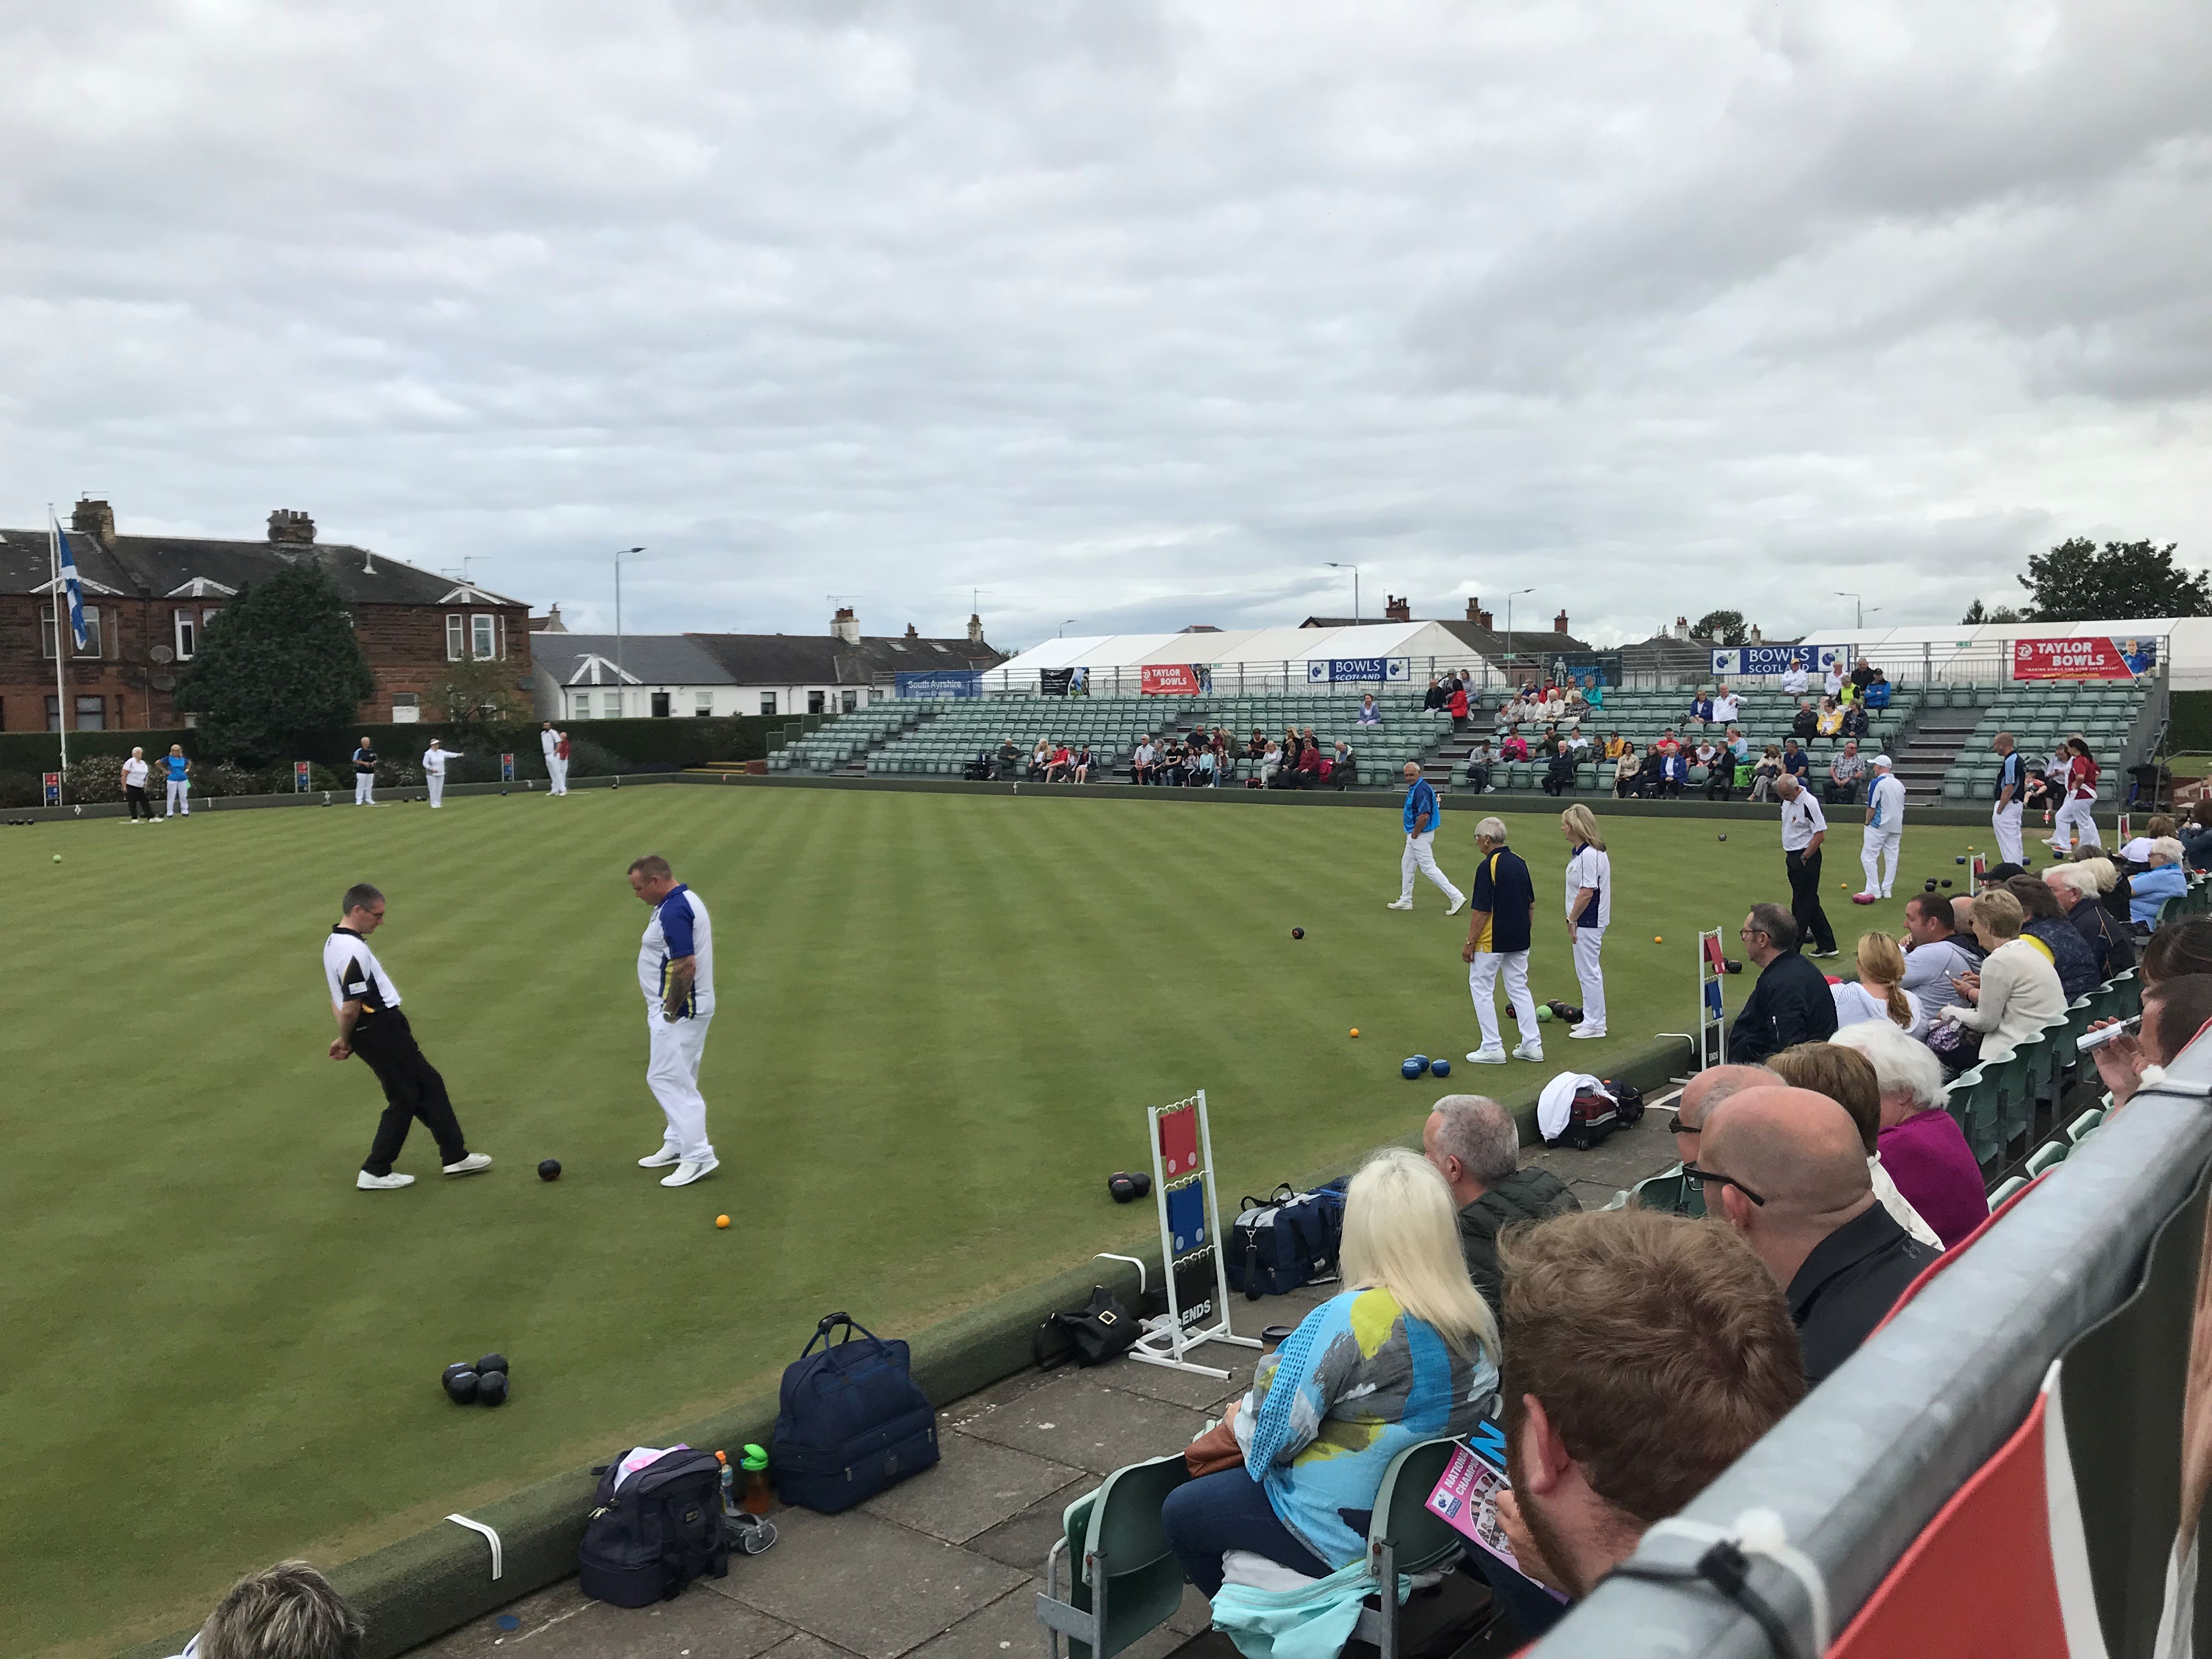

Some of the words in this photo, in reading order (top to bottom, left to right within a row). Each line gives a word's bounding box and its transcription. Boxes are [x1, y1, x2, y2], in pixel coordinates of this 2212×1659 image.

[2037, 642, 2092, 654] TAYLOR
[1749, 647, 1809, 662] BOWLS
[2052, 654, 2104, 666] BOWLS
[1336, 660, 1380, 673] BOWLS
[1568, 666, 1604, 676] PROSTATE
[1748, 664, 1809, 673] SCOTLAD
[1152, 668, 1181, 677] TAYLOR
[907, 680, 930, 689] South
[930, 680, 962, 690] Ayrshire
[1160, 678, 1187, 686] BOWLS
[1182, 1299, 1211, 1325] ENDS
